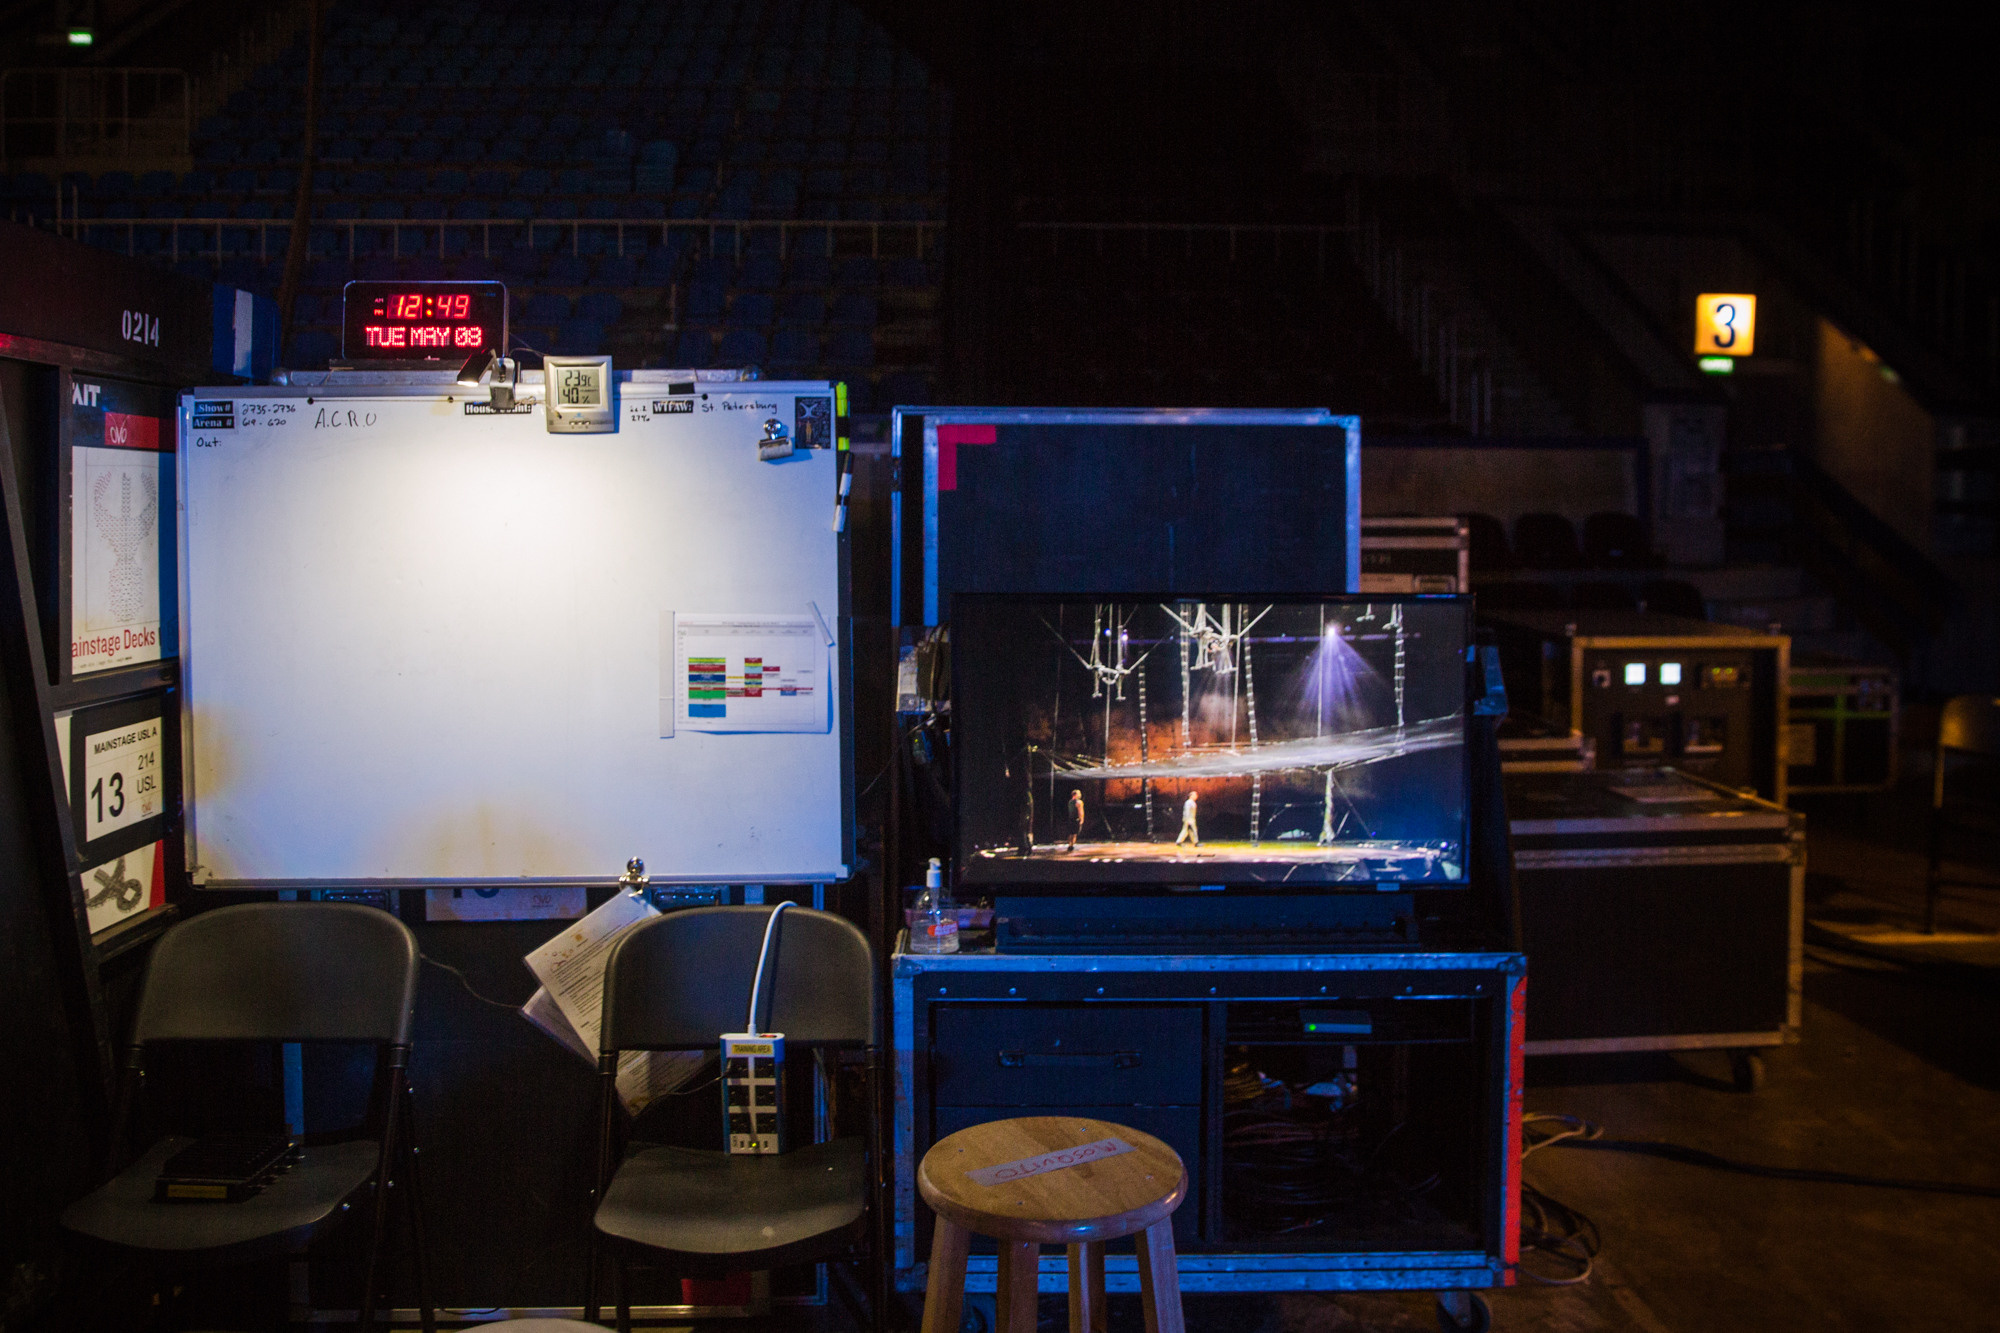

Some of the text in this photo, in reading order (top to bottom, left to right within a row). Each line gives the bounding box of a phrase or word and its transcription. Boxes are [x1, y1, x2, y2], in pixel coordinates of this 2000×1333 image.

[397, 295, 470, 318] 12:49
[122, 309, 160, 348] 0214
[366, 326, 483, 347] TUE MAY 08
[1713, 303, 1736, 348] 3
[71, 382, 101, 408] AIT
[701, 400, 778, 415] St. Petersburg
[194, 418, 223, 427] Arena
[72, 626, 156, 658] ainstage Decks
[94, 726, 158, 755] MAINSTAGE USL A
[137, 751, 155, 771] 214
[136, 774, 157, 794] USL
[91, 771, 125, 824] 13
